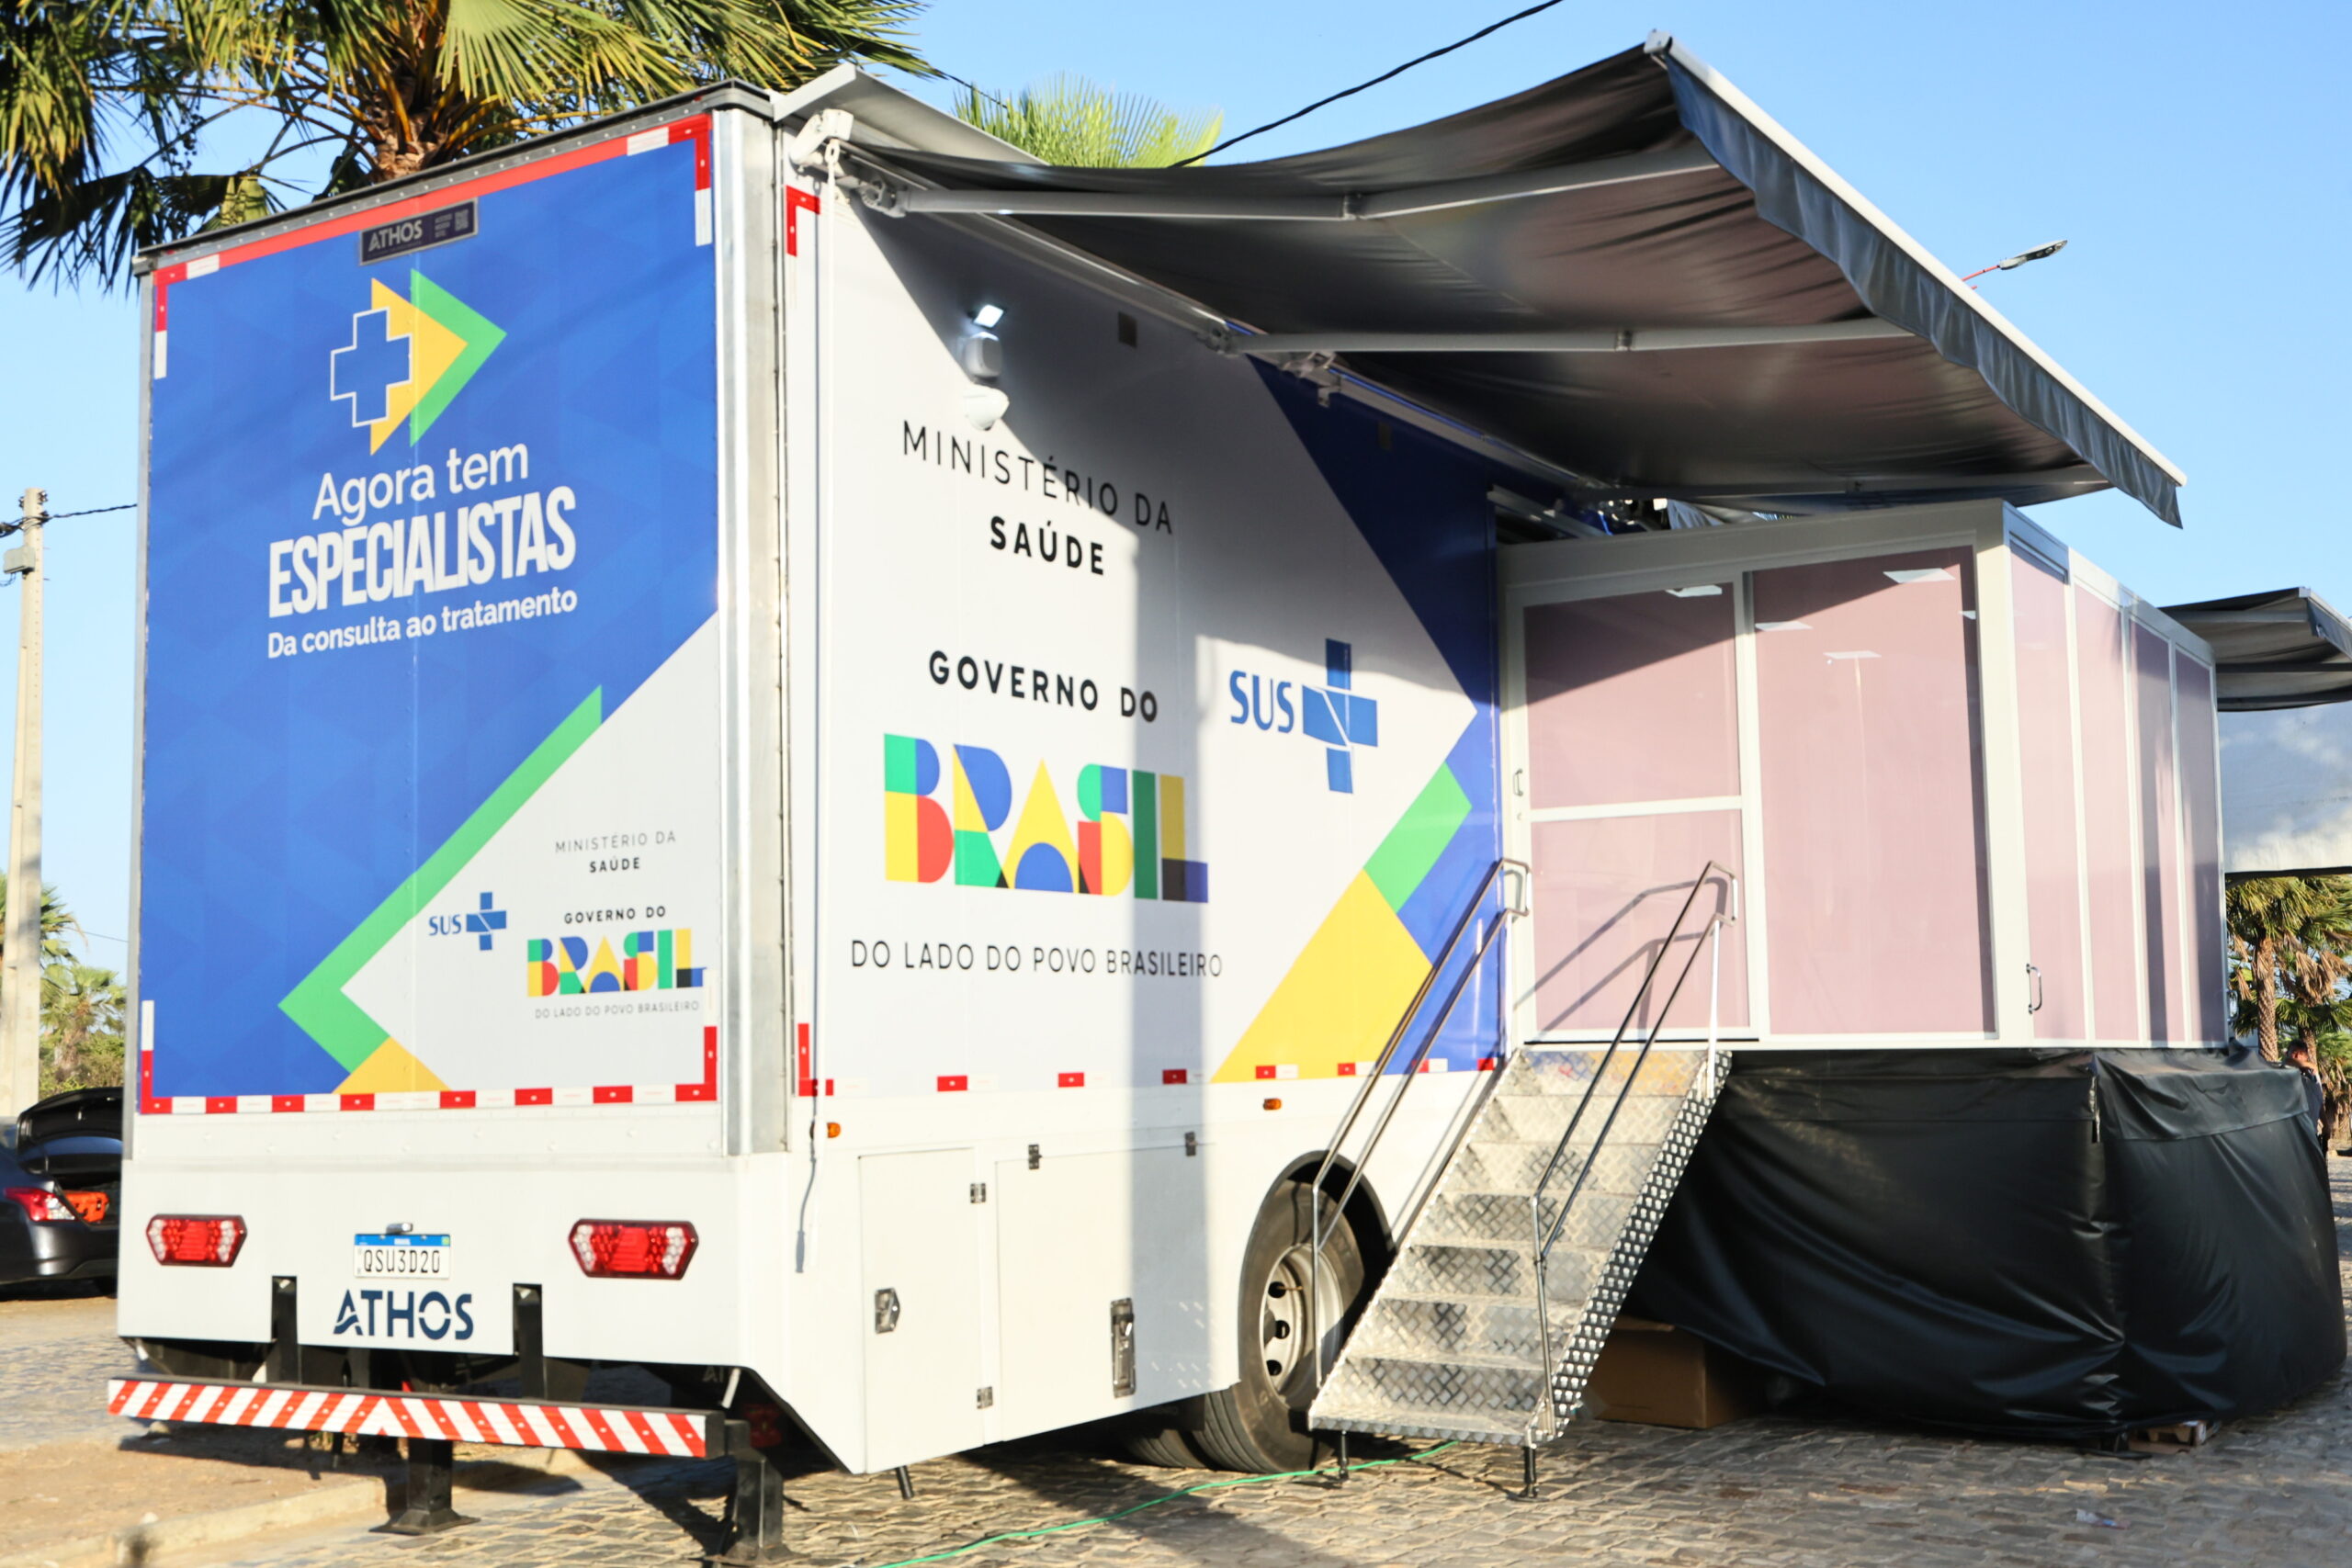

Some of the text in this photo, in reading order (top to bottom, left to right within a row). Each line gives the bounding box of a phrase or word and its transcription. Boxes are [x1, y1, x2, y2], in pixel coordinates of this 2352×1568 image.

[368, 219, 423, 253] ATHOS
[311, 442, 529, 527] Agora tem
[903, 419, 1172, 535] MINISTÉRIO DA
[267, 485, 577, 618] ESPECIALISTAS
[989, 514, 1103, 576] SAÚDE
[267, 585, 578, 659] Da consulta ao tratamento
[928, 649, 1159, 724] GOVERNO DO
[1229, 670, 1295, 734] SUS
[555, 829, 677, 854] MINISTÉRIO DA
[883, 732, 1209, 904] BRASIL
[589, 854, 640, 874] SAÚDE
[428, 913, 462, 937] SUS
[563, 905, 667, 925] GOVERNO DO
[526, 927, 707, 998] BRASIL
[851, 939, 1223, 977] DO LADO DO POVO BRASILEIRO
[535, 1000, 700, 1019] DO LADO DO POVO BRASILEIRO
[333, 1289, 474, 1340] ATHOS
